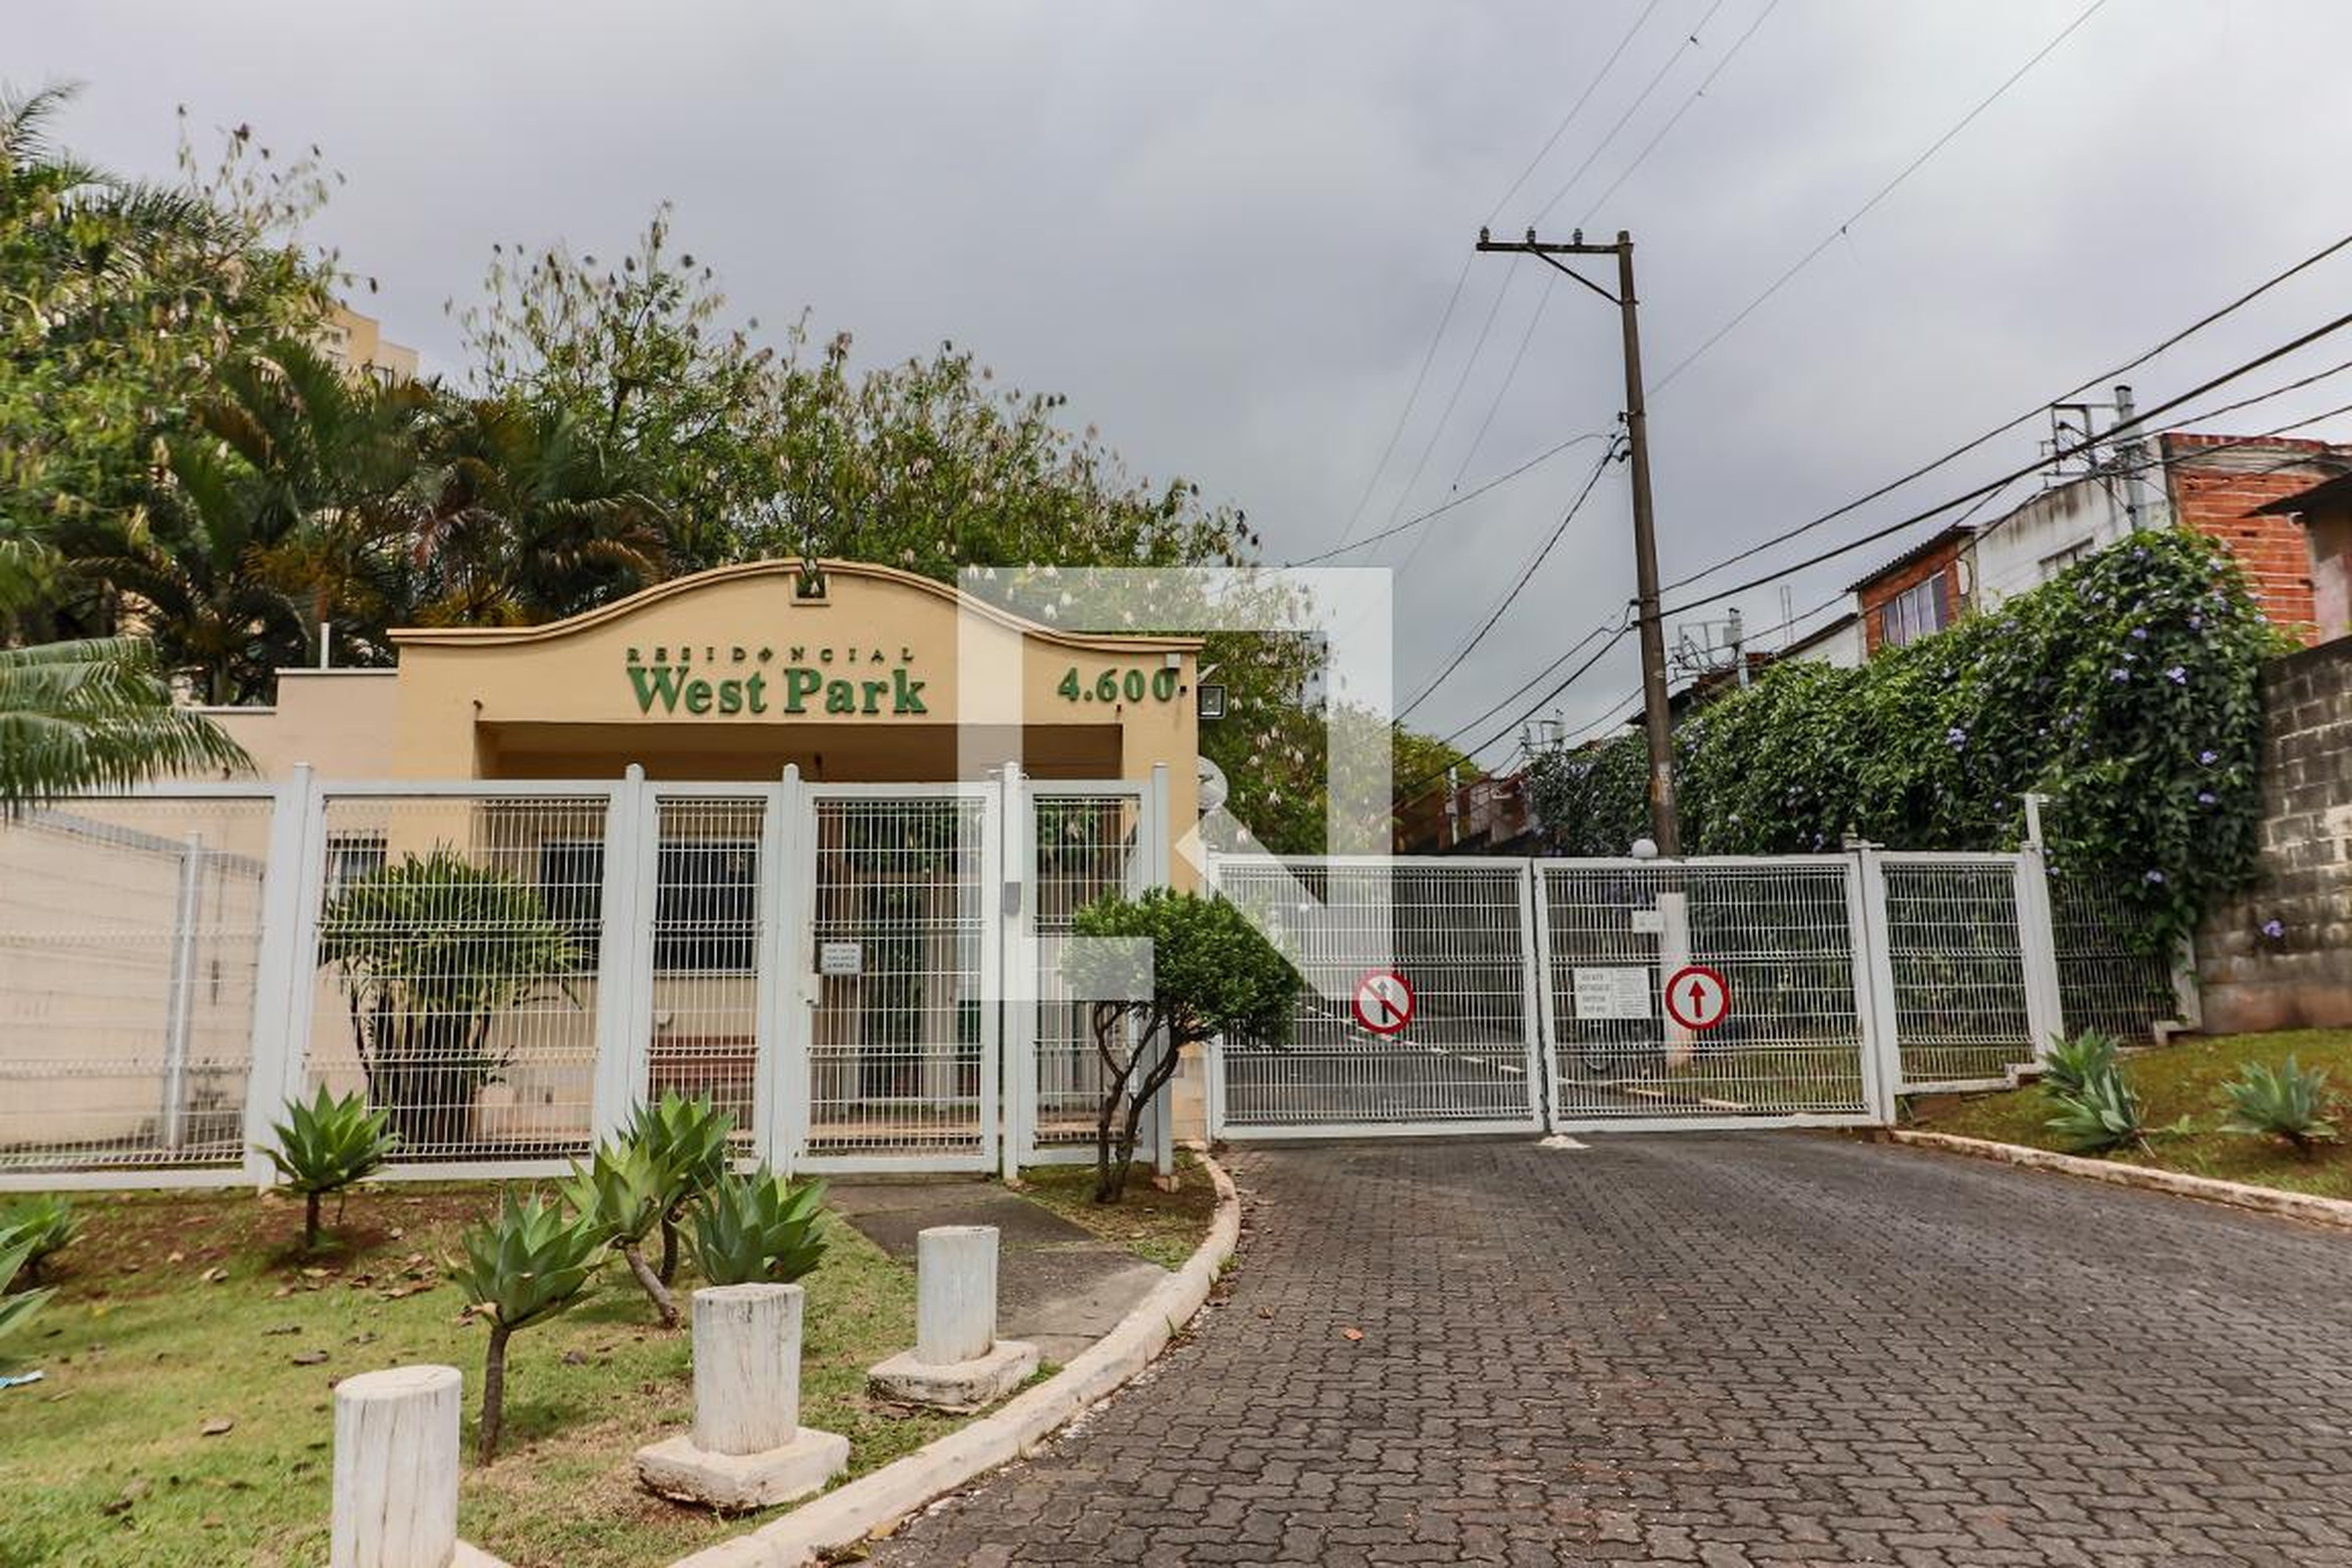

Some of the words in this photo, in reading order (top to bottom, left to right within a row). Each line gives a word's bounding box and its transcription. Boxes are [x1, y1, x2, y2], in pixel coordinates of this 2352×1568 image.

[627, 666, 768, 715] West
[783, 668, 928, 714] Park
[1058, 667, 1175, 703] 4.600
